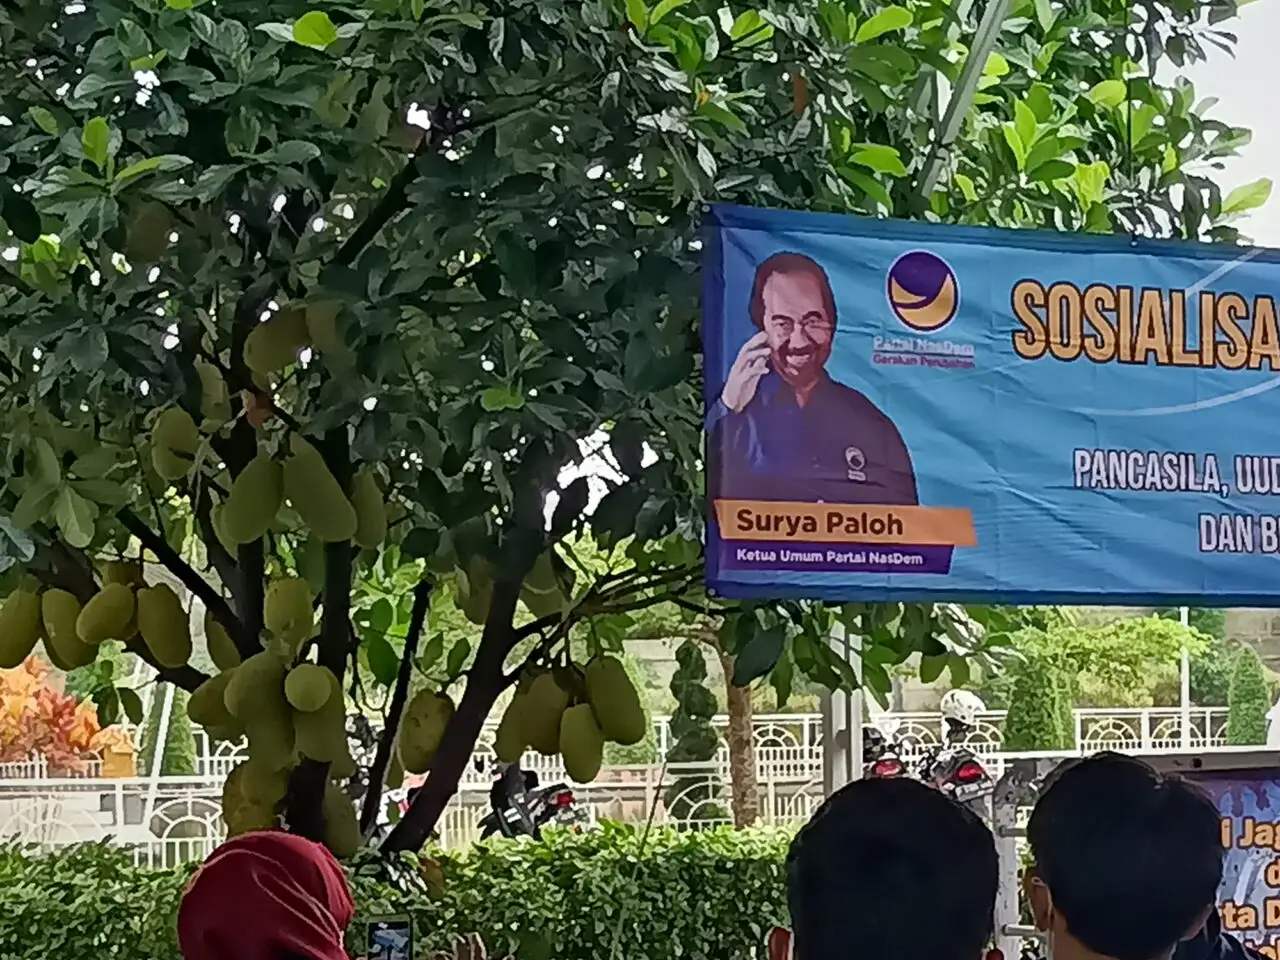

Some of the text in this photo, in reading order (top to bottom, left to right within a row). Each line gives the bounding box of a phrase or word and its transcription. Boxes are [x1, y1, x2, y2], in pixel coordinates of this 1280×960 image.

[1073, 448, 1230, 498] PANCASILA,
[736, 509, 904, 537] Surya Paloh
[1199, 513, 1253, 552] DAN
[736, 548, 923, 566] Ketua Umum Partai NasDem
